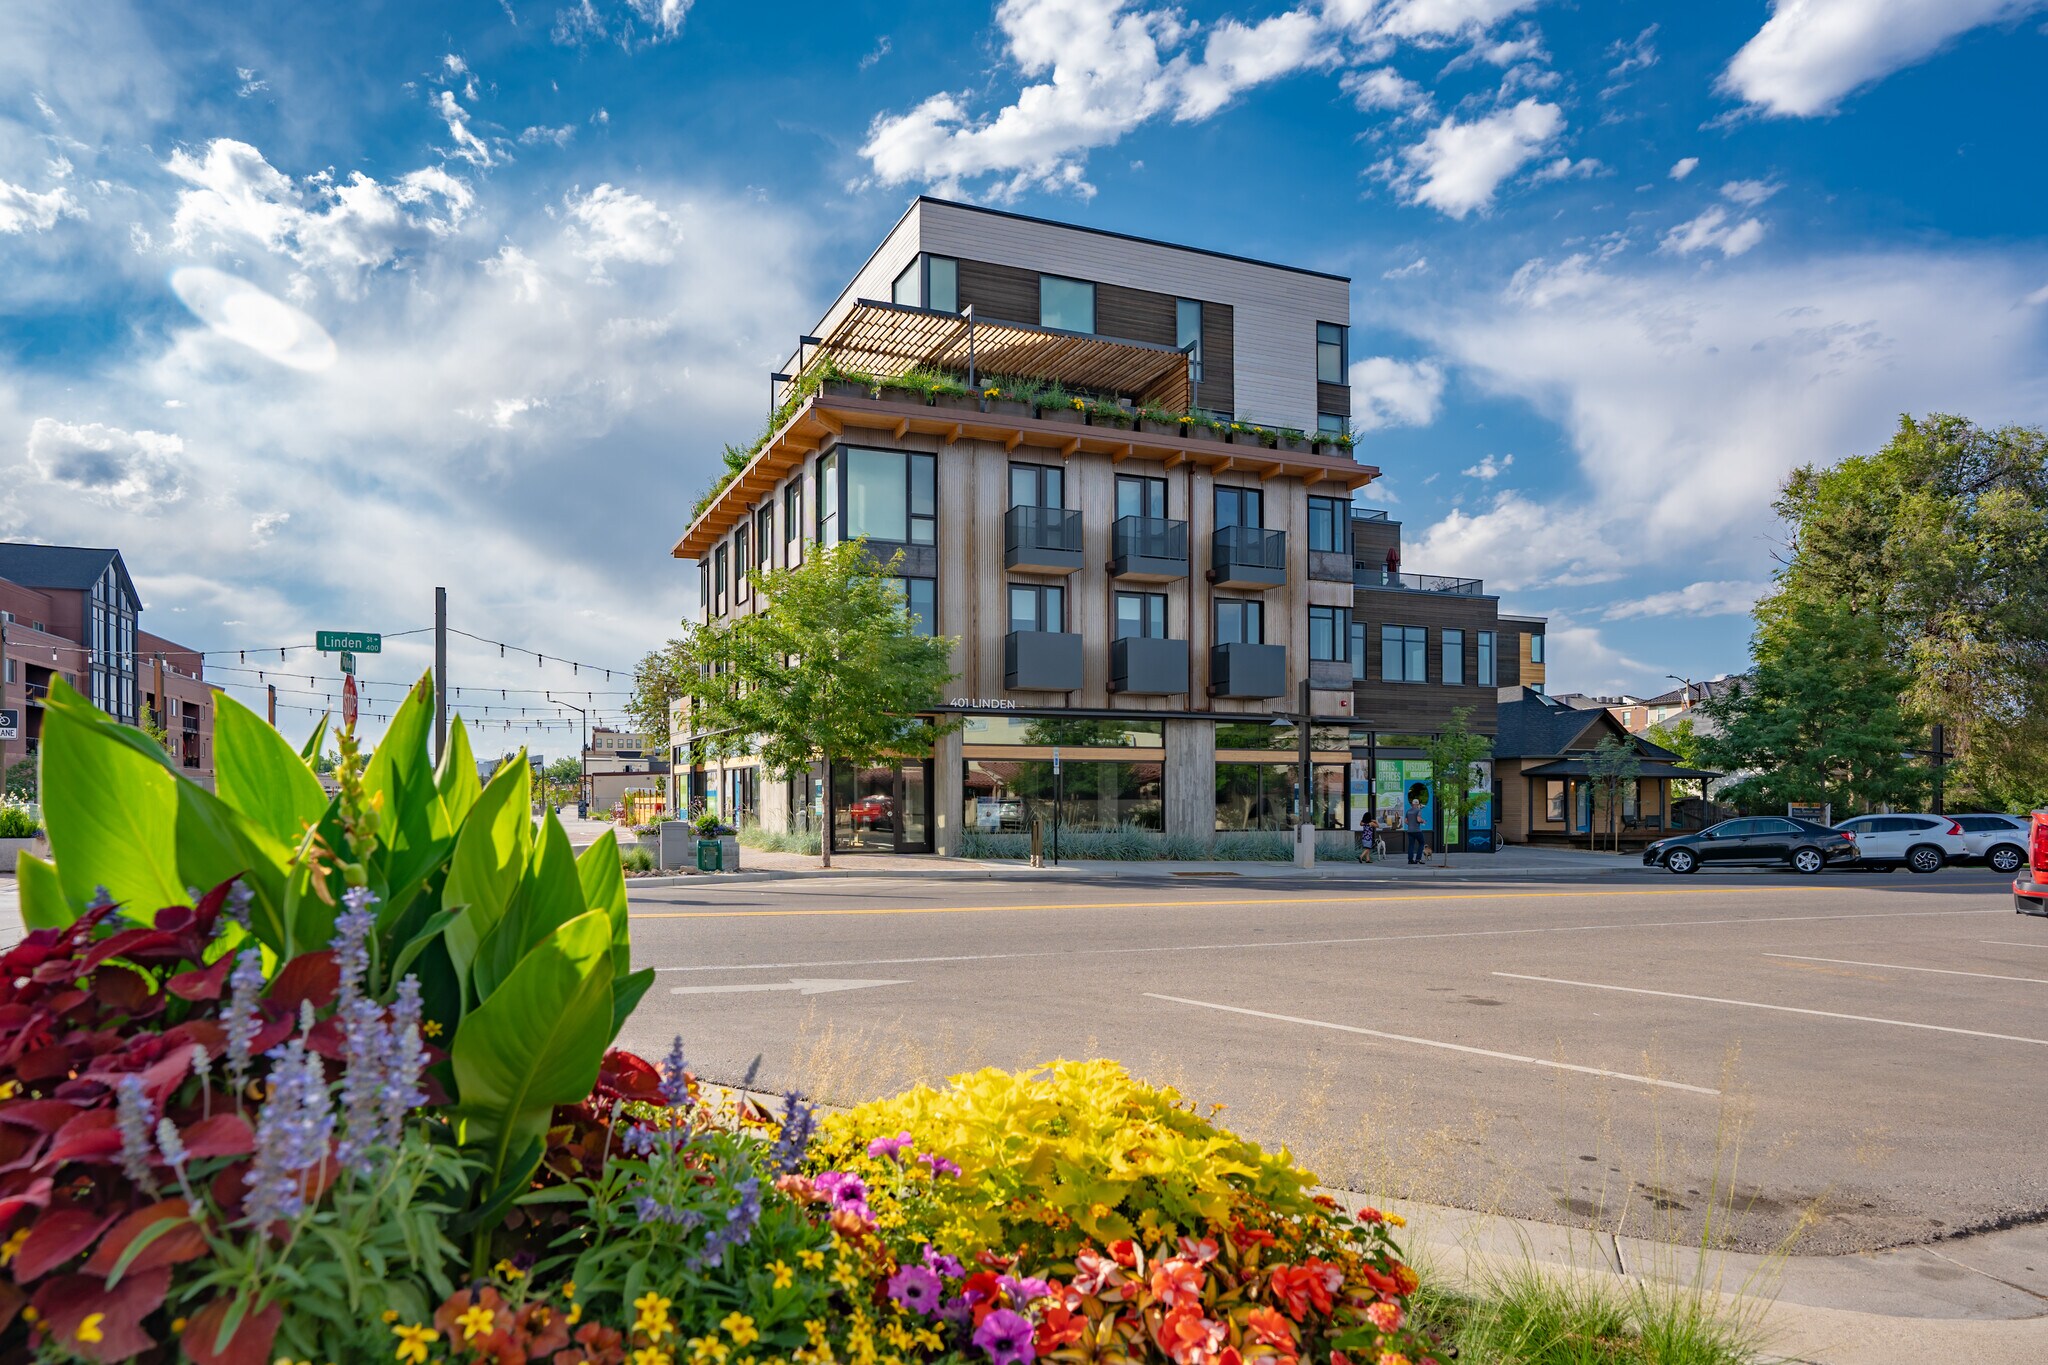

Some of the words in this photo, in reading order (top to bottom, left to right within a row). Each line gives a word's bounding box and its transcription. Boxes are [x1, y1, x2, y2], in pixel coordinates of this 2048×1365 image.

[324, 636, 362, 648] Linden
[344, 694, 357, 715] STOP
[950, 698, 969, 708] 401
[972, 698, 1015, 709] LINDEN
[0, 729, 15, 737] ANE
[1378, 772, 1401, 781] OFFICES
